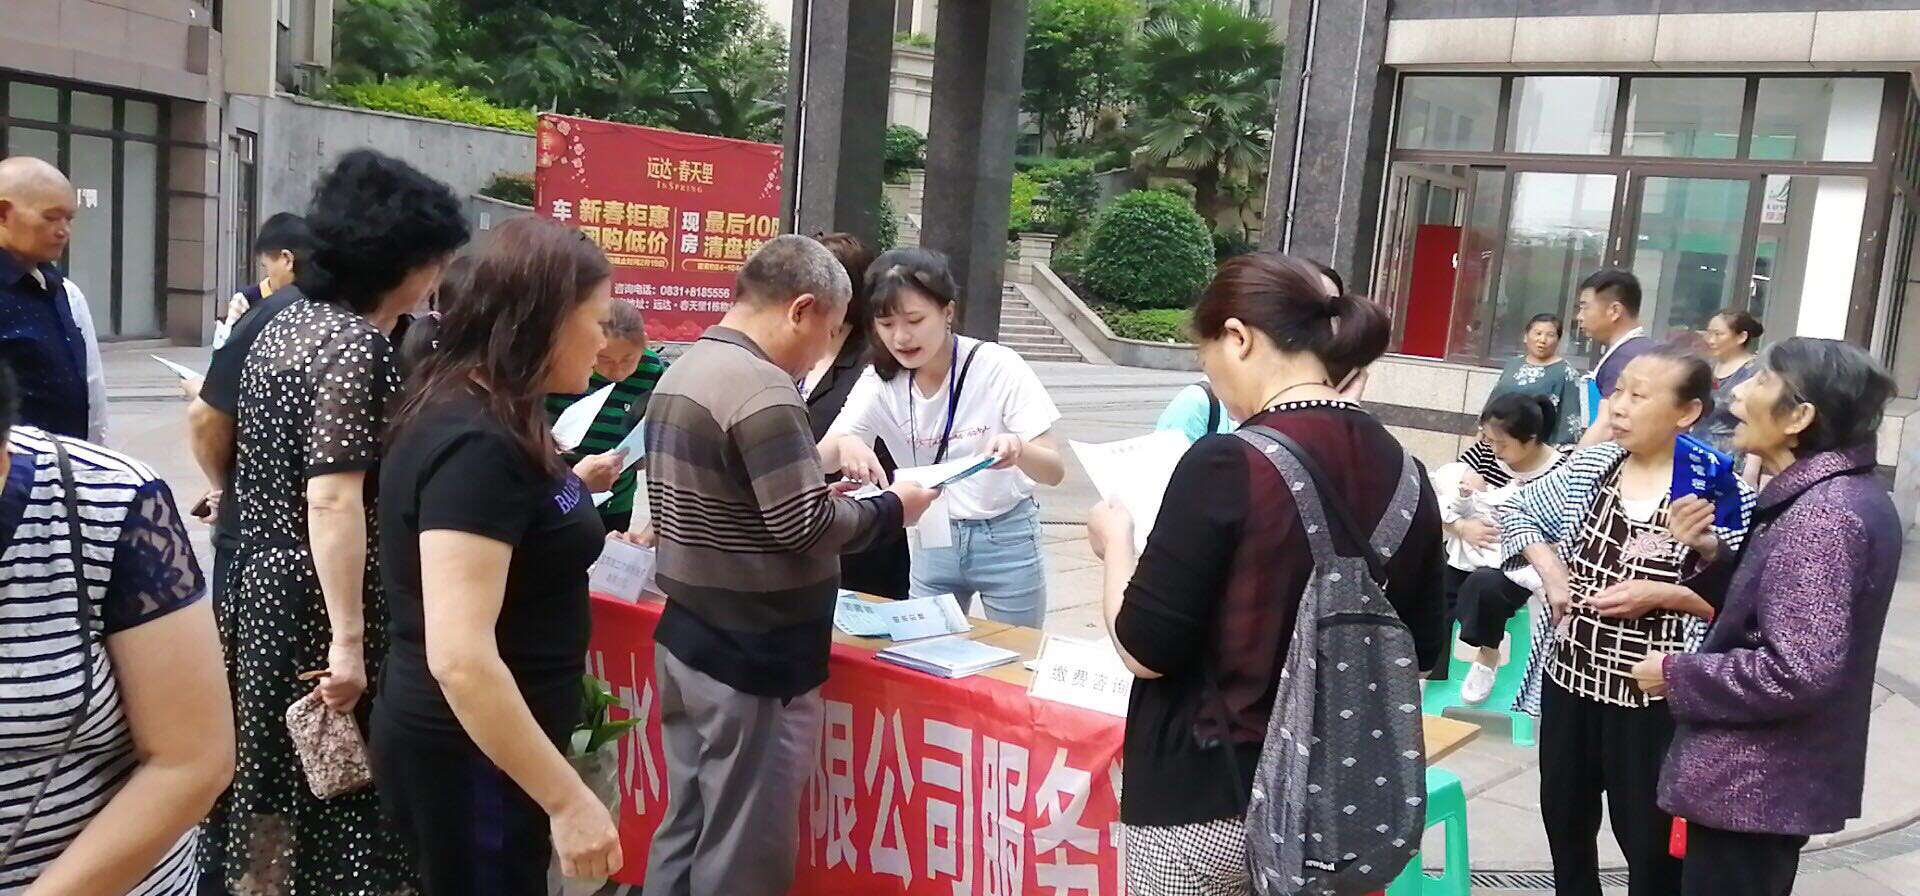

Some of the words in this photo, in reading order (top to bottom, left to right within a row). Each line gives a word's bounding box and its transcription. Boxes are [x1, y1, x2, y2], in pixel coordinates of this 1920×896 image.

[647, 156, 714, 185] 远达·春天里
[552, 199, 572, 222] 车
[579, 198, 670, 229] 新春钜惠
[680, 211, 700, 254] 现房
[1049, 664, 1130, 697] 缴费咨询
[811, 698, 1127, 896] 限公司服务
